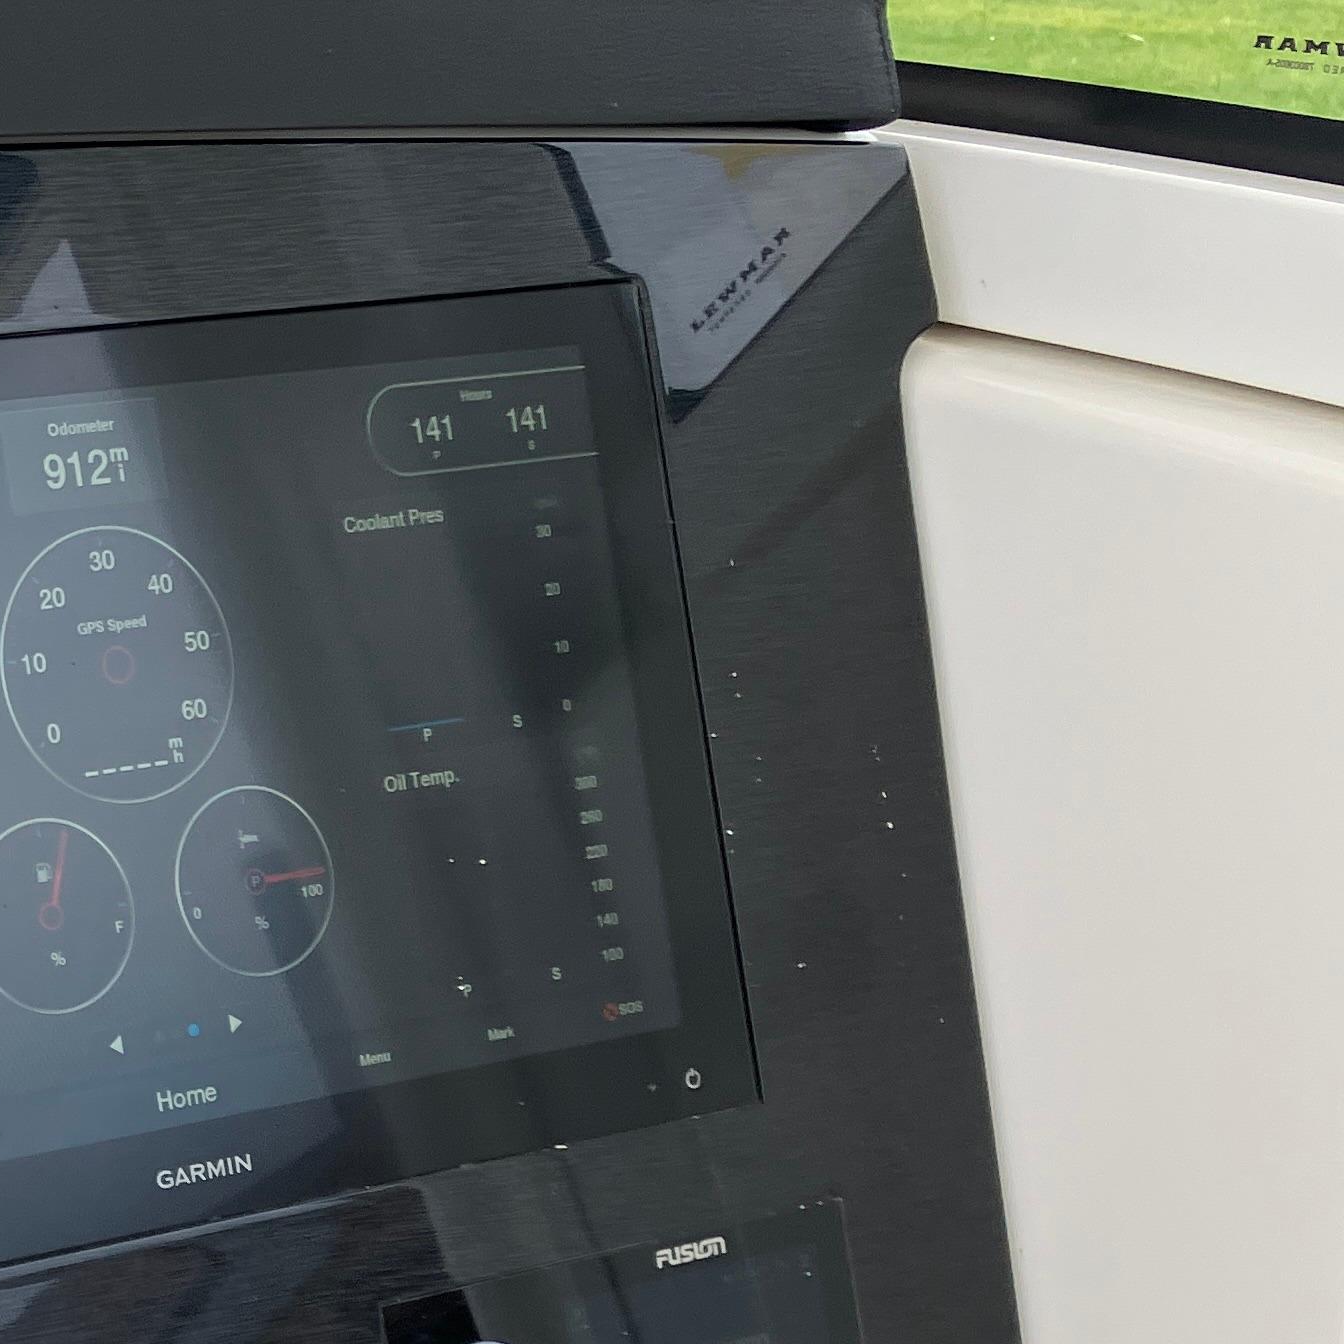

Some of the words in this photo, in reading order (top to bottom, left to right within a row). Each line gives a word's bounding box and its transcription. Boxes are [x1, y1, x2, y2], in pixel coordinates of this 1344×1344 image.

[47, 419, 114, 436] Odometer
[410, 415, 453, 443] 141
[506, 405, 548, 432] 141
[344, 512, 403, 533] Coolant
[89, 550, 115, 572] 30
[77, 620, 105, 635] GPS
[107, 615, 147, 634] Speed
[184, 630, 210, 652] 50
[384, 775, 406, 793] Oil
[411, 769, 460, 790] Temp.
[360, 1051, 391, 1067] Menu
[156, 1086, 218, 1112] Home
[156, 1153, 253, 1190] GARMIN
[656, 1236, 726, 1268] FUSION
